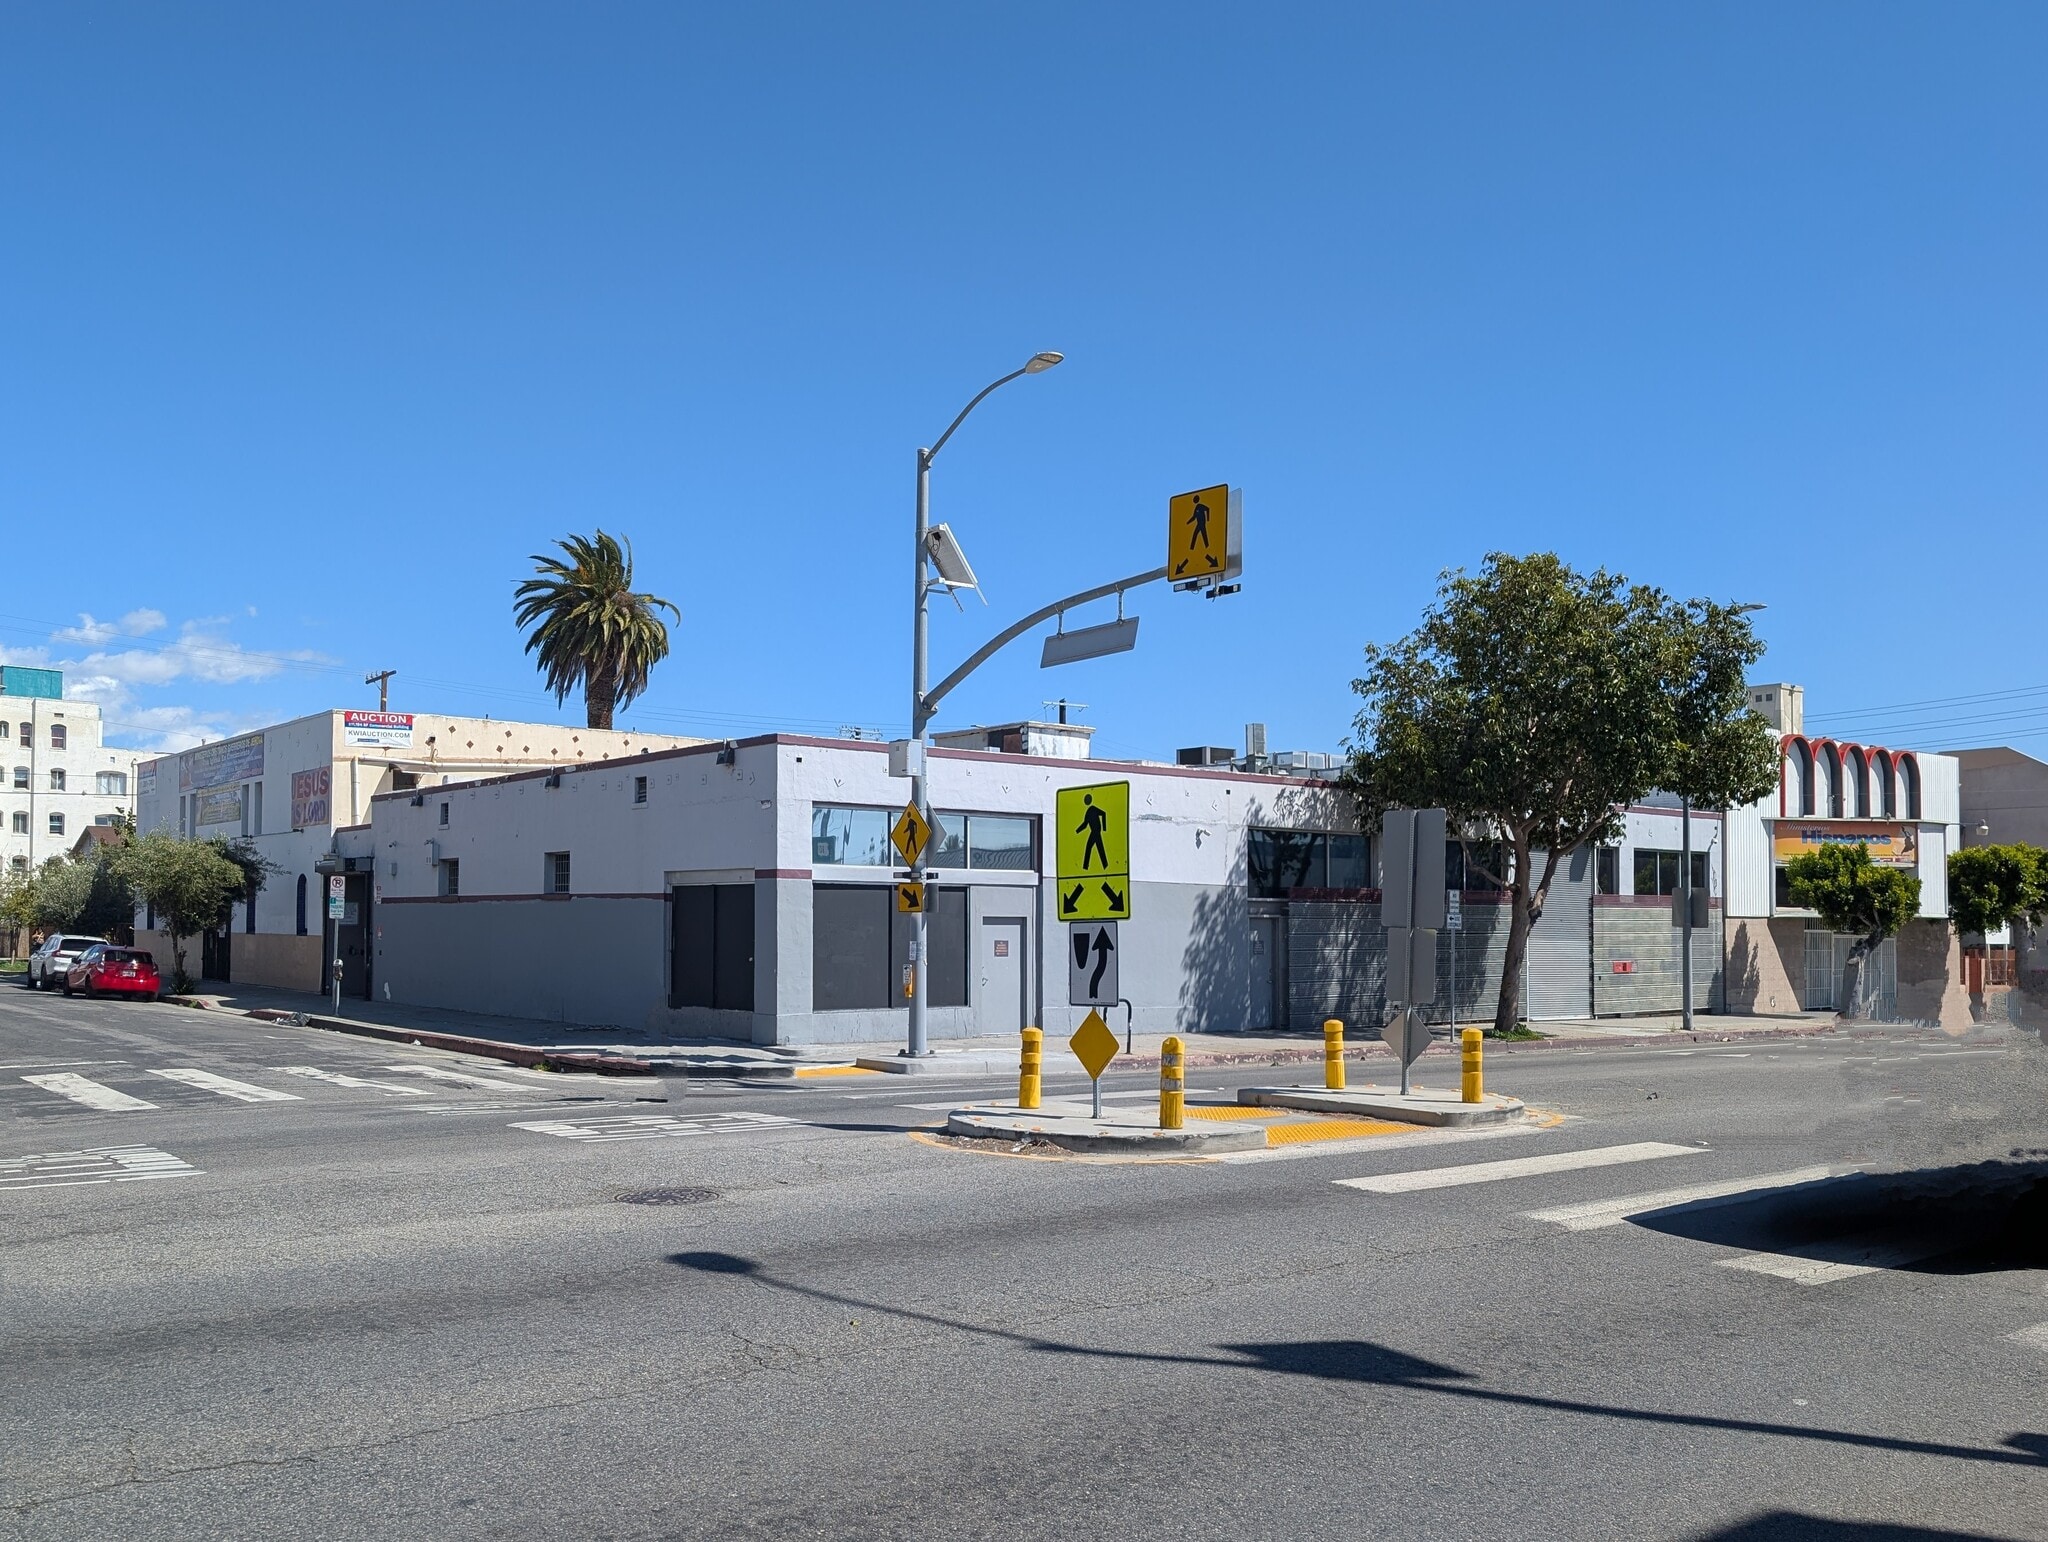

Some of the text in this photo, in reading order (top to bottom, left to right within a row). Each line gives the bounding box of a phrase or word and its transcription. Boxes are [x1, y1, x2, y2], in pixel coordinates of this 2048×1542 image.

[351, 713, 407, 724] AUCTION
[348, 730, 411, 738] KWIAUCTION.COM
[292, 769, 329, 801] JESUS
[304, 801, 325, 823] LORD
[1801, 830, 1892, 845] Hispanos
